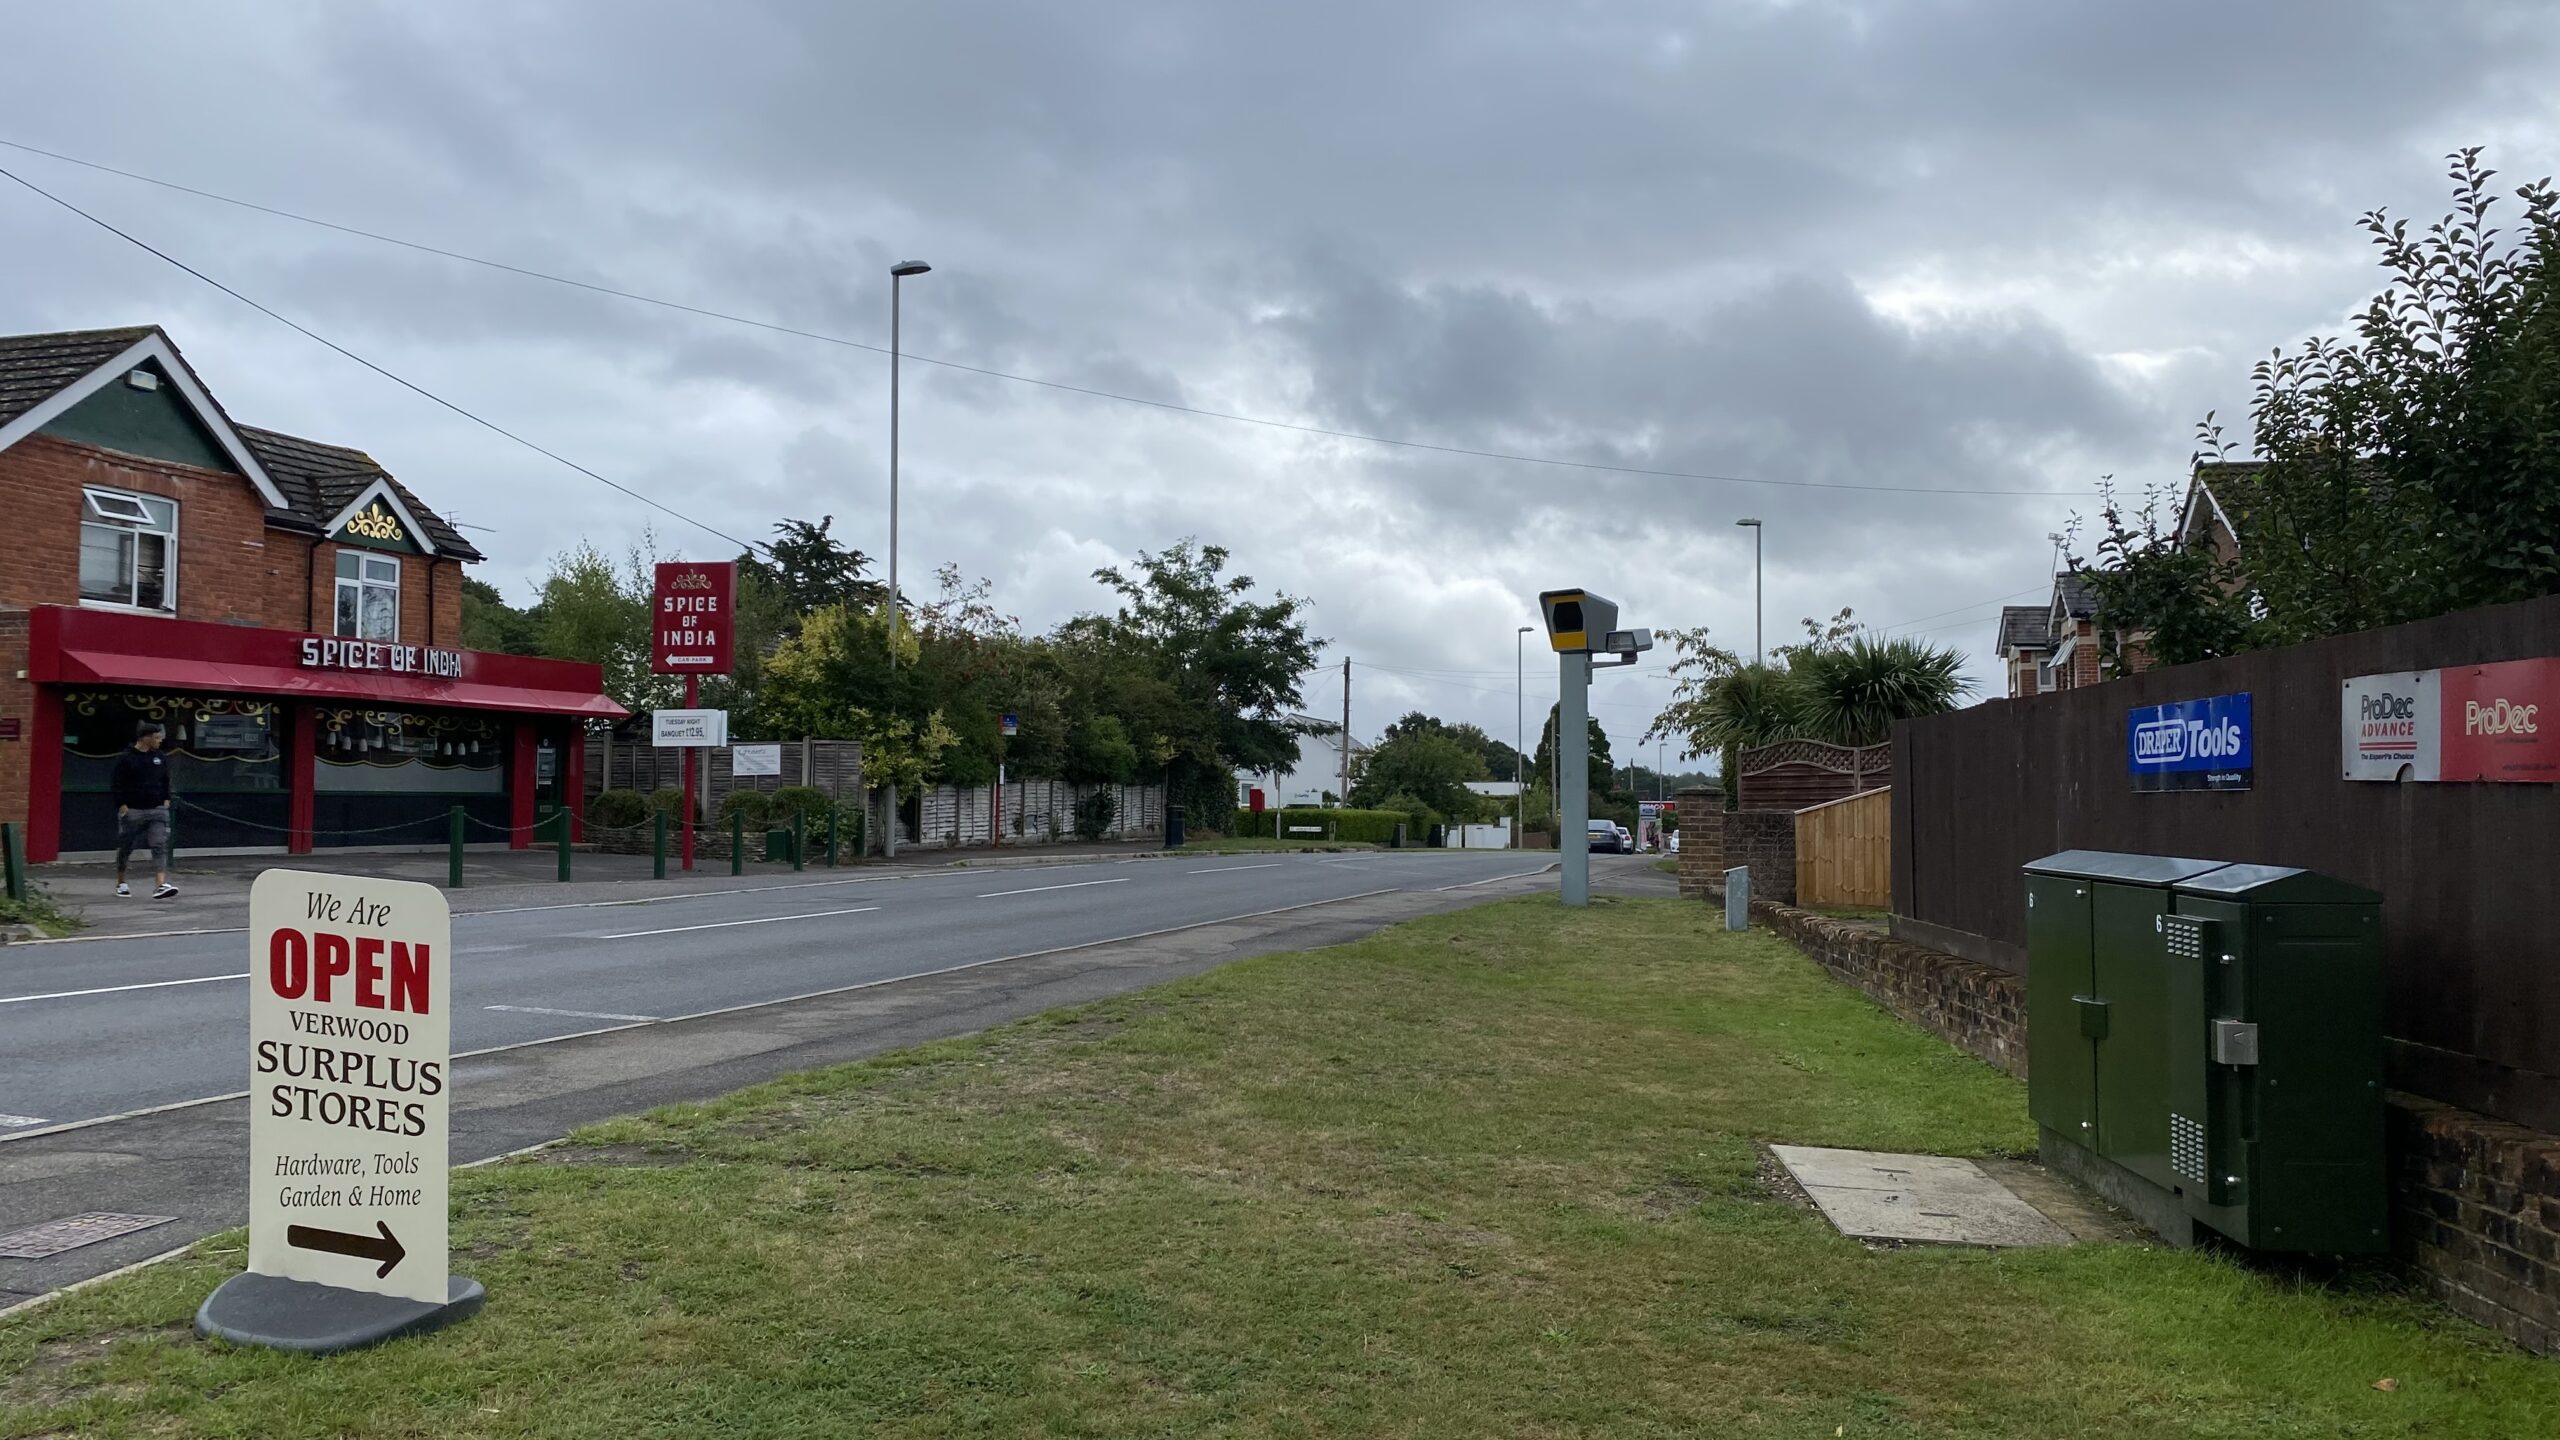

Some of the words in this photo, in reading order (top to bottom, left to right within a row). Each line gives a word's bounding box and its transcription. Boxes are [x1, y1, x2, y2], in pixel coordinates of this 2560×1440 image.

[664, 596, 718, 612] SPICE
[682, 615, 698, 628] OF
[663, 630, 716, 646] INDIA
[302, 638, 380, 669] SPICE
[391, 645, 416, 672] OF
[424, 648, 462, 678] INDIA
[2361, 693, 2415, 720] ProDec
[2466, 698, 2539, 735] ProDec
[2138, 728, 2182, 756] DRAPER
[2188, 716, 2241, 758] Tools
[2361, 721, 2415, 738] ADVANCE
[2393, 752, 2415, 760] Choice
[307, 891, 342, 922] We
[346, 896, 391, 928] Are
[2029, 892, 2034, 908] 6
[2156, 914, 2162, 933] 6
[270, 927, 430, 1015] OPEN
[289, 1010, 409, 1045] VERWOOD
[257, 1040, 442, 1096] SURPLUS
[271, 1084, 427, 1137] STORES
[275, 1152, 366, 1178] Hardware,
[374, 1150, 420, 1175] Tools
[280, 1184, 342, 1208] Garden
[348, 1184, 364, 1208] &
[369, 1184, 422, 1208] Home
